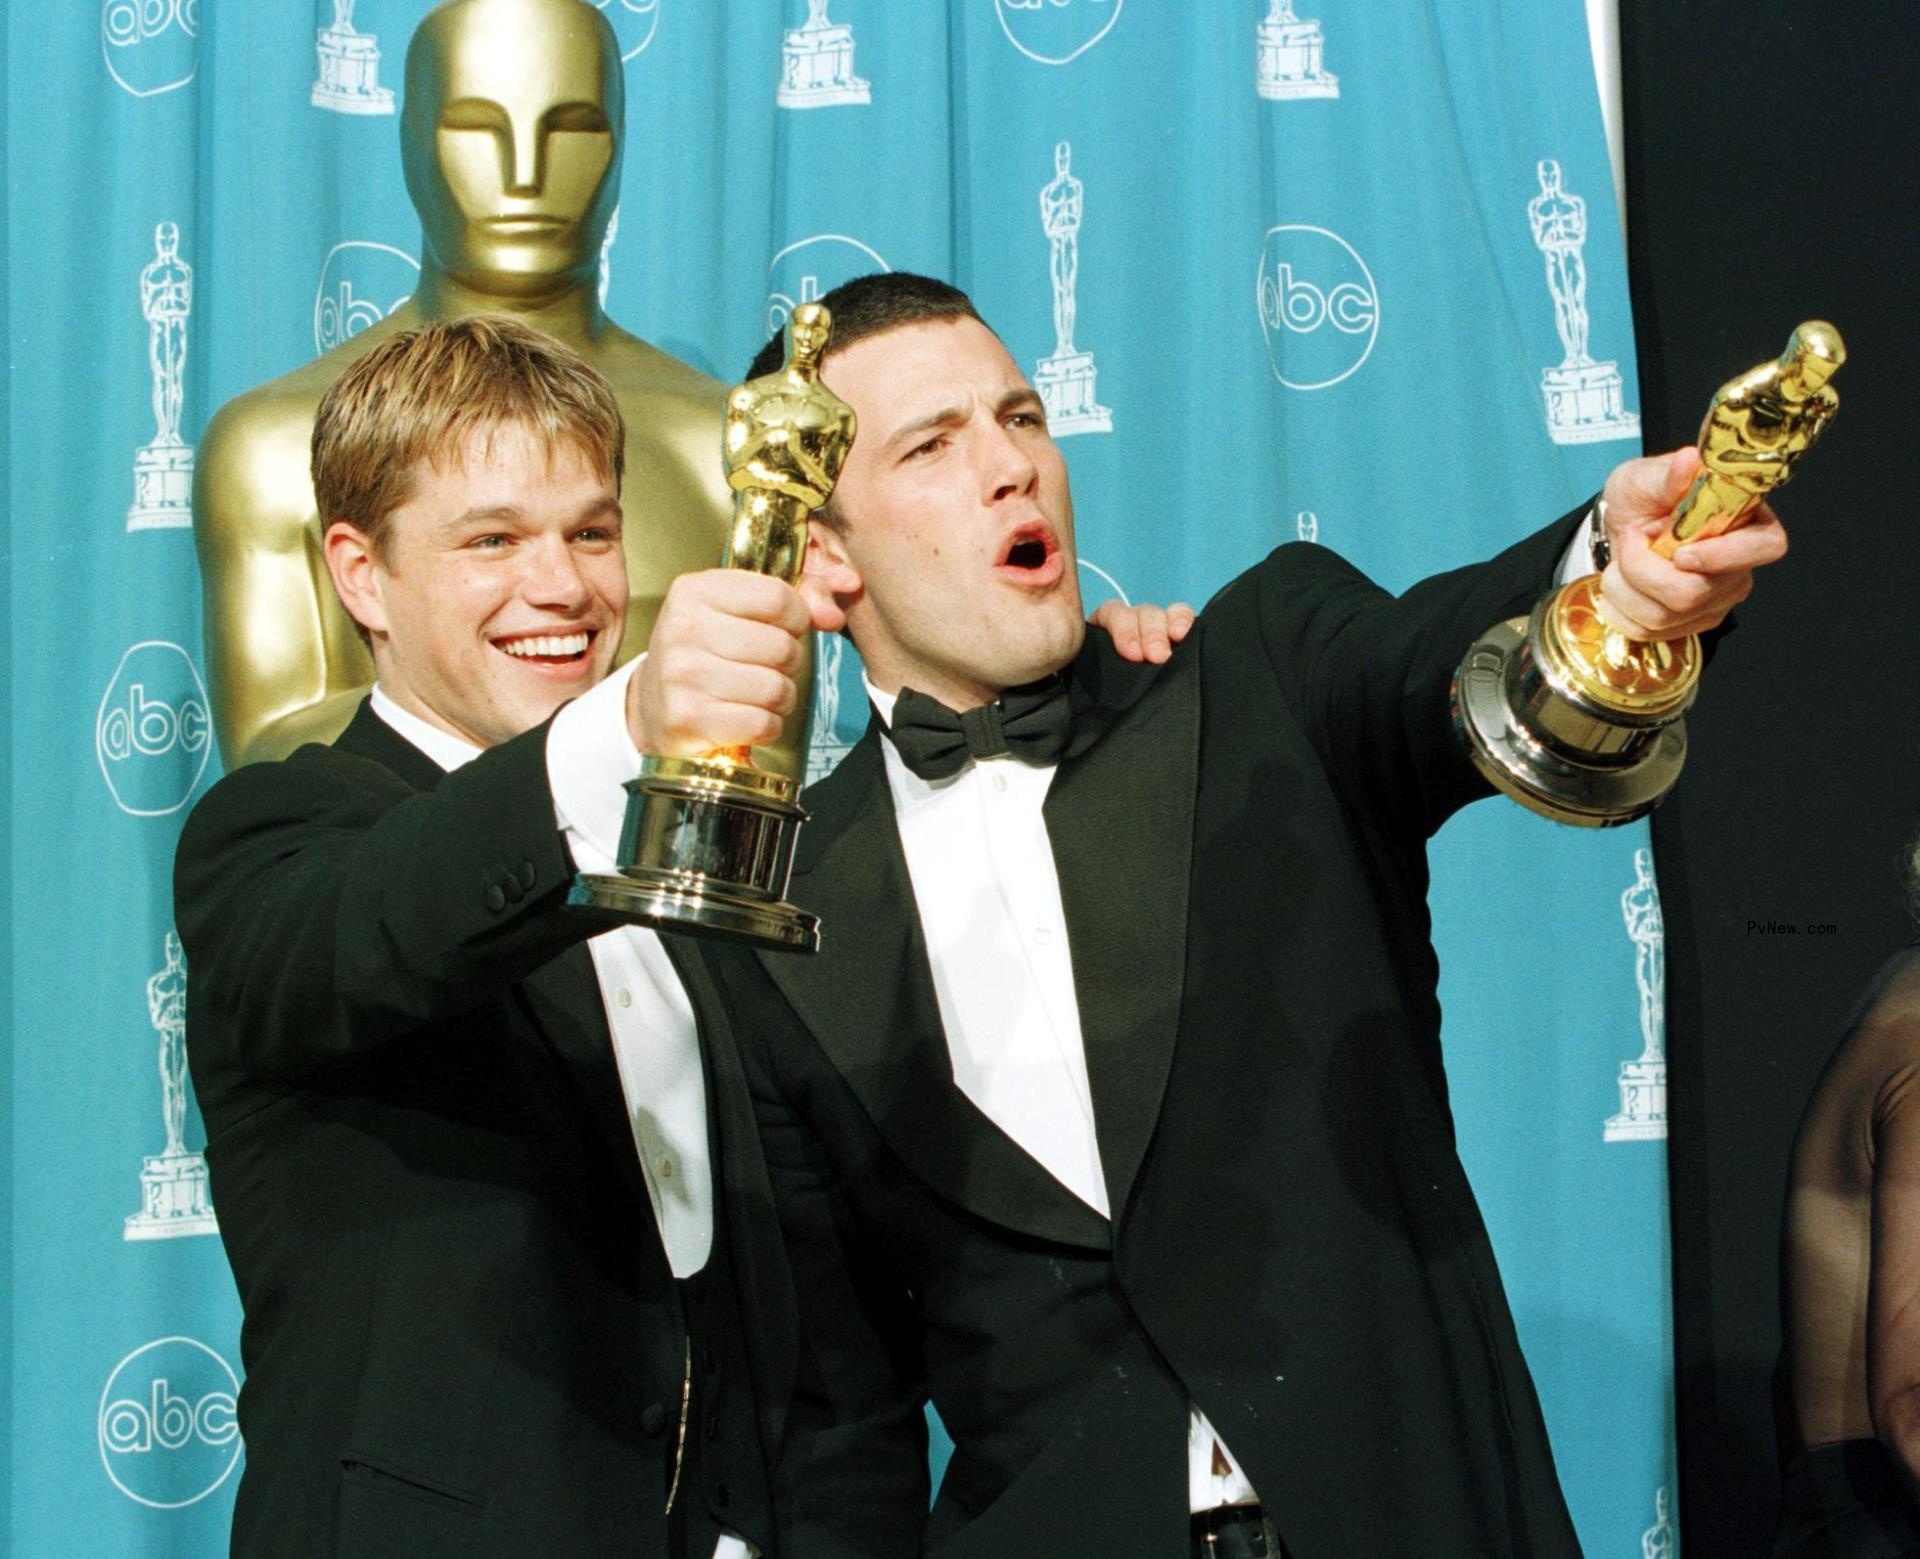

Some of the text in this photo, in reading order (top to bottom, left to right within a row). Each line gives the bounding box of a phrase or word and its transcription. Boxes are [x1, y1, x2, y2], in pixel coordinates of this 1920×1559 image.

[320, 281, 410, 348] ab
[1261, 263, 1374, 333] abc
[102, 684, 207, 761] abc
[103, 1379, 238, 1452] abc
